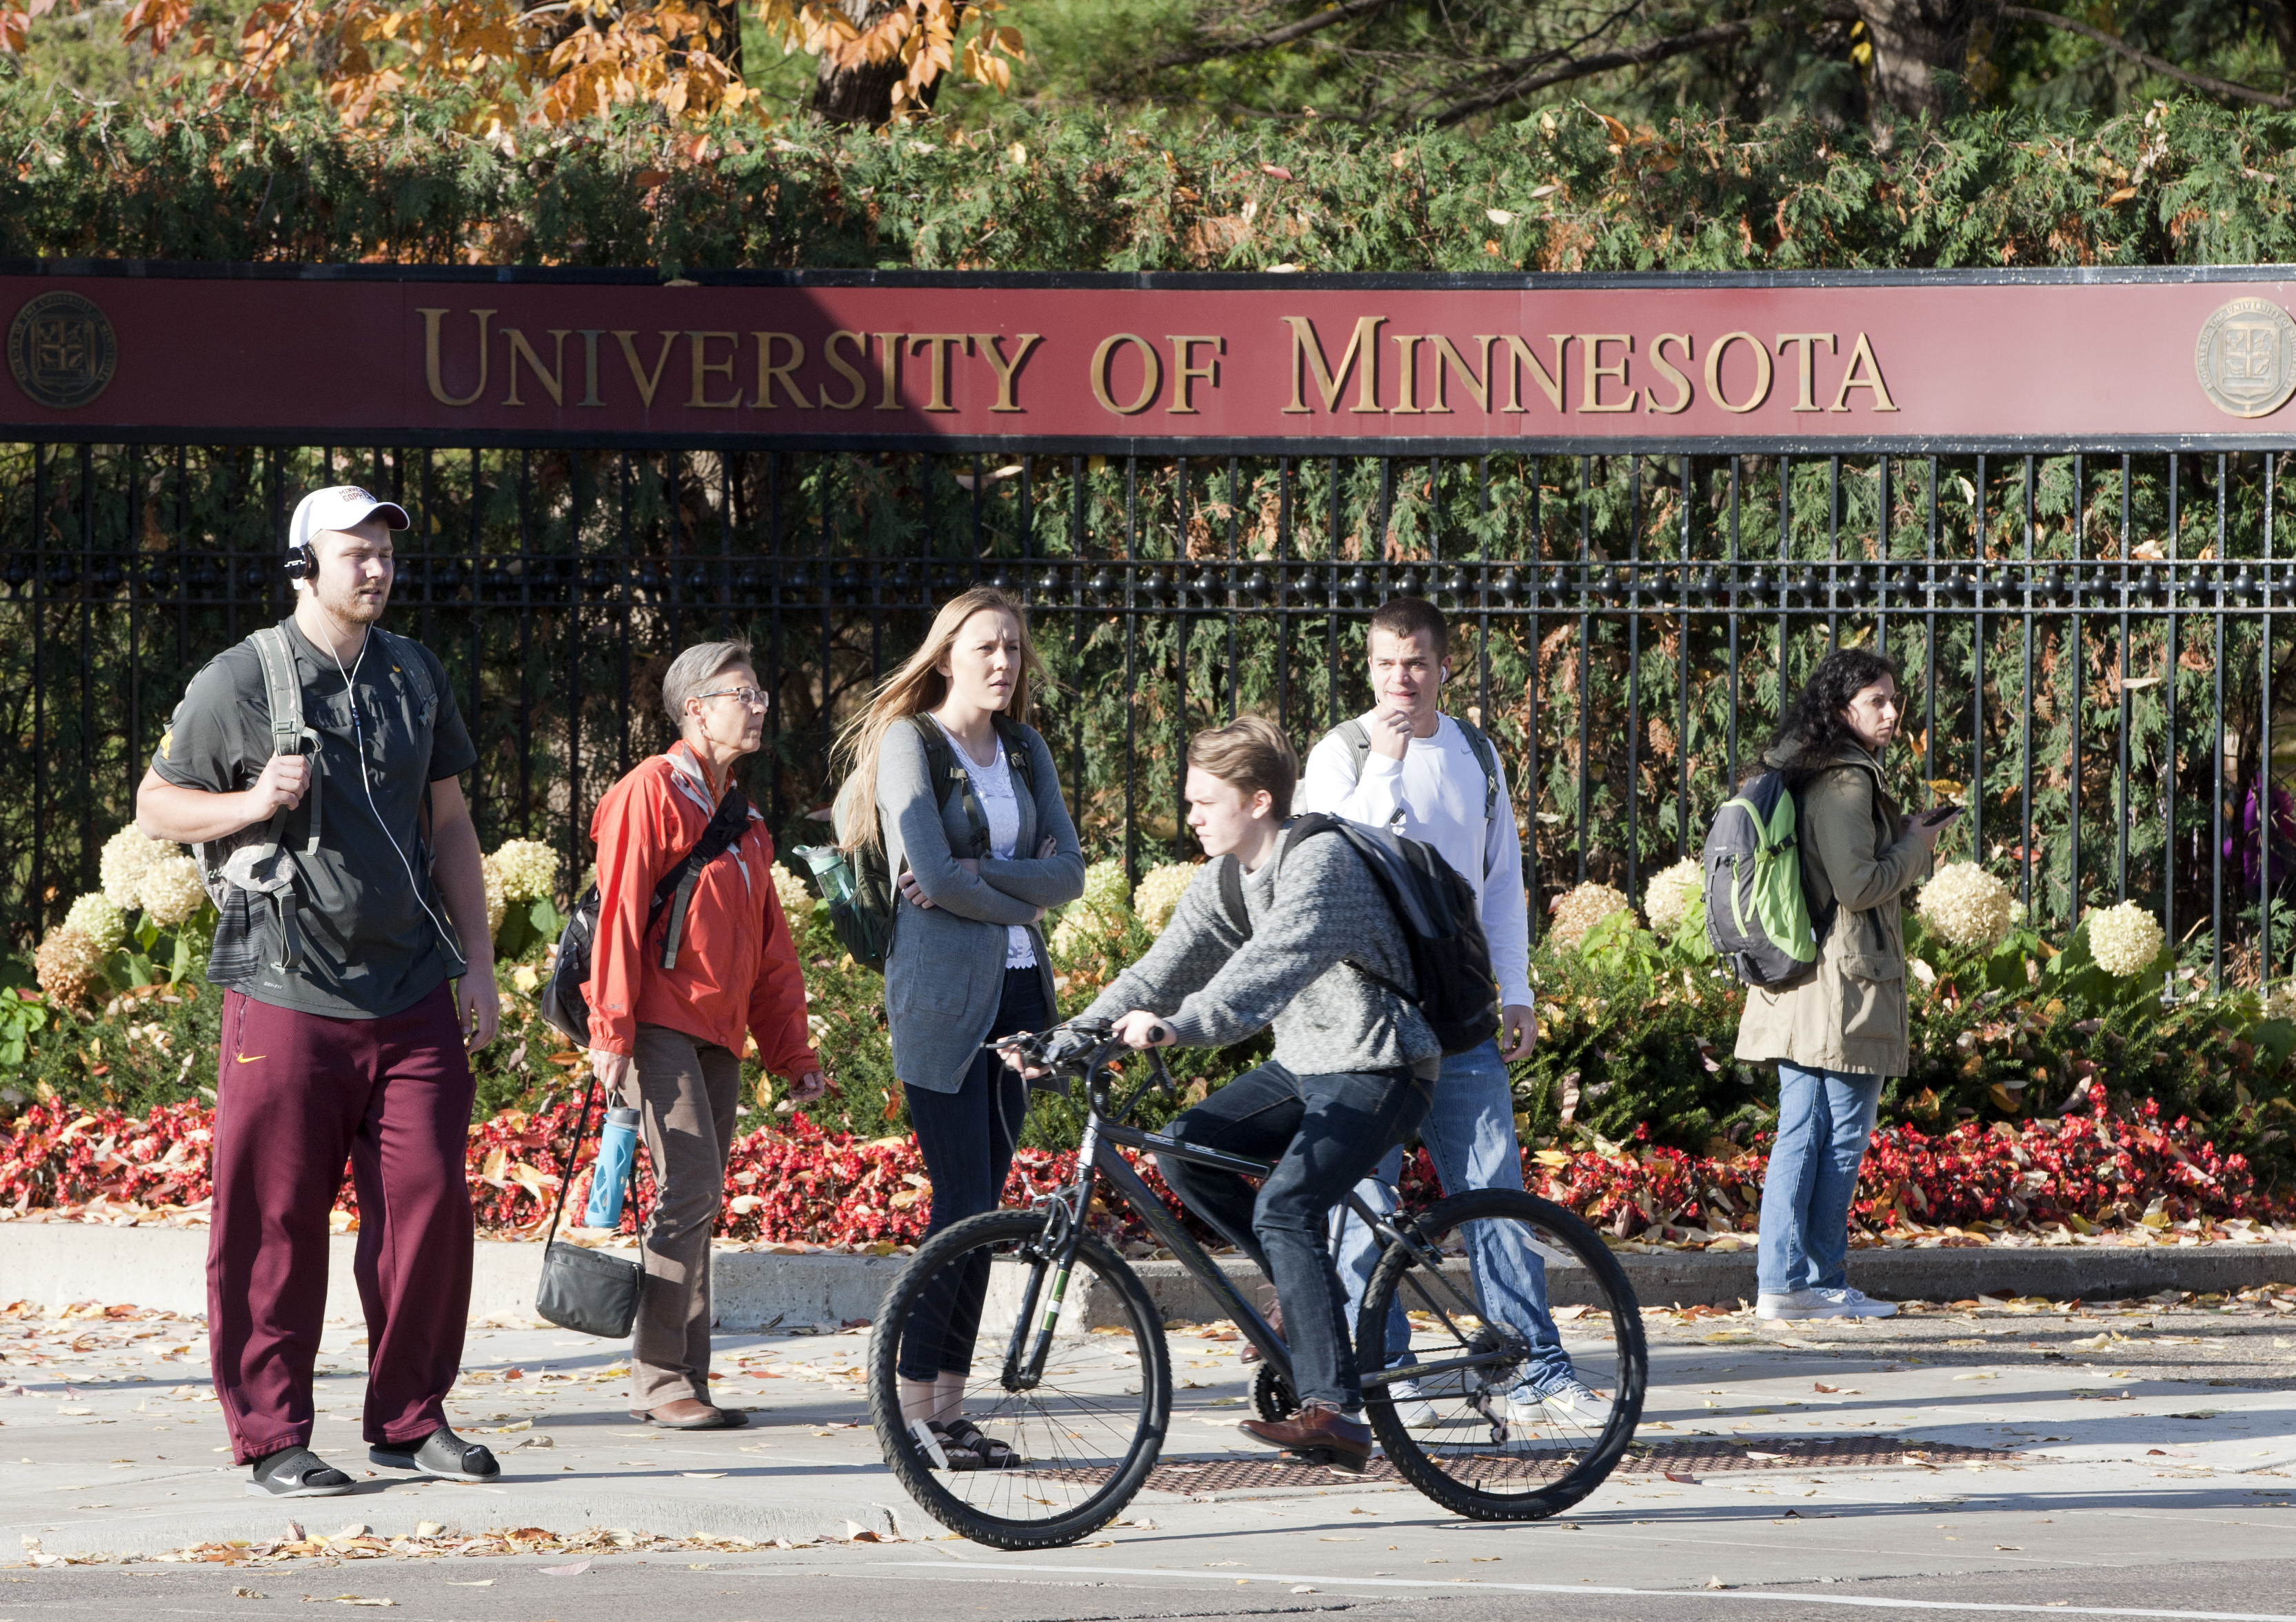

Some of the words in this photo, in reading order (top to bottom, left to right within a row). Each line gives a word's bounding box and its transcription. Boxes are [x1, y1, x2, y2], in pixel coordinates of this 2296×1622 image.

[2226, 302, 2279, 319] UNIVERSITY
[415, 308, 1041, 412] UNIVERSITY
[1089, 332, 1225, 415] OF
[1278, 314, 1900, 415] MINNESOTA
